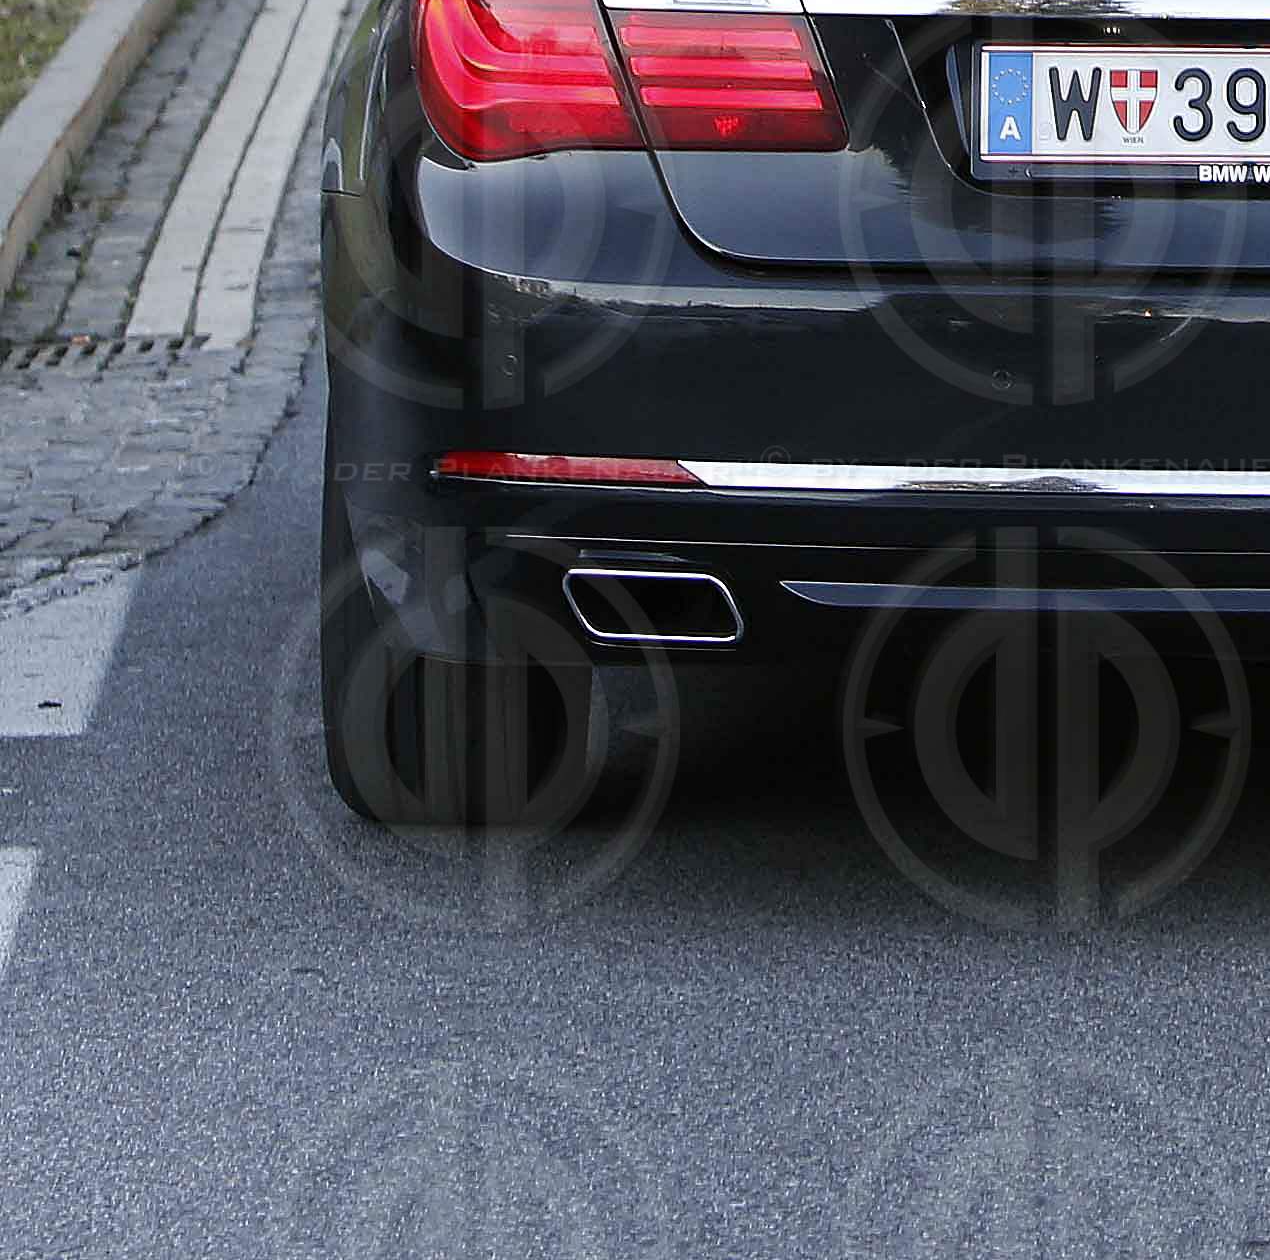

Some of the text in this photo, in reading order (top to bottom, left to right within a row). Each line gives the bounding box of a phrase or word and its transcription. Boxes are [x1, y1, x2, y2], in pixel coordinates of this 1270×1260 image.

[1048, 65, 1101, 142] W
[999, 115, 1021, 141] A
[1198, 164, 1249, 183] BMW
